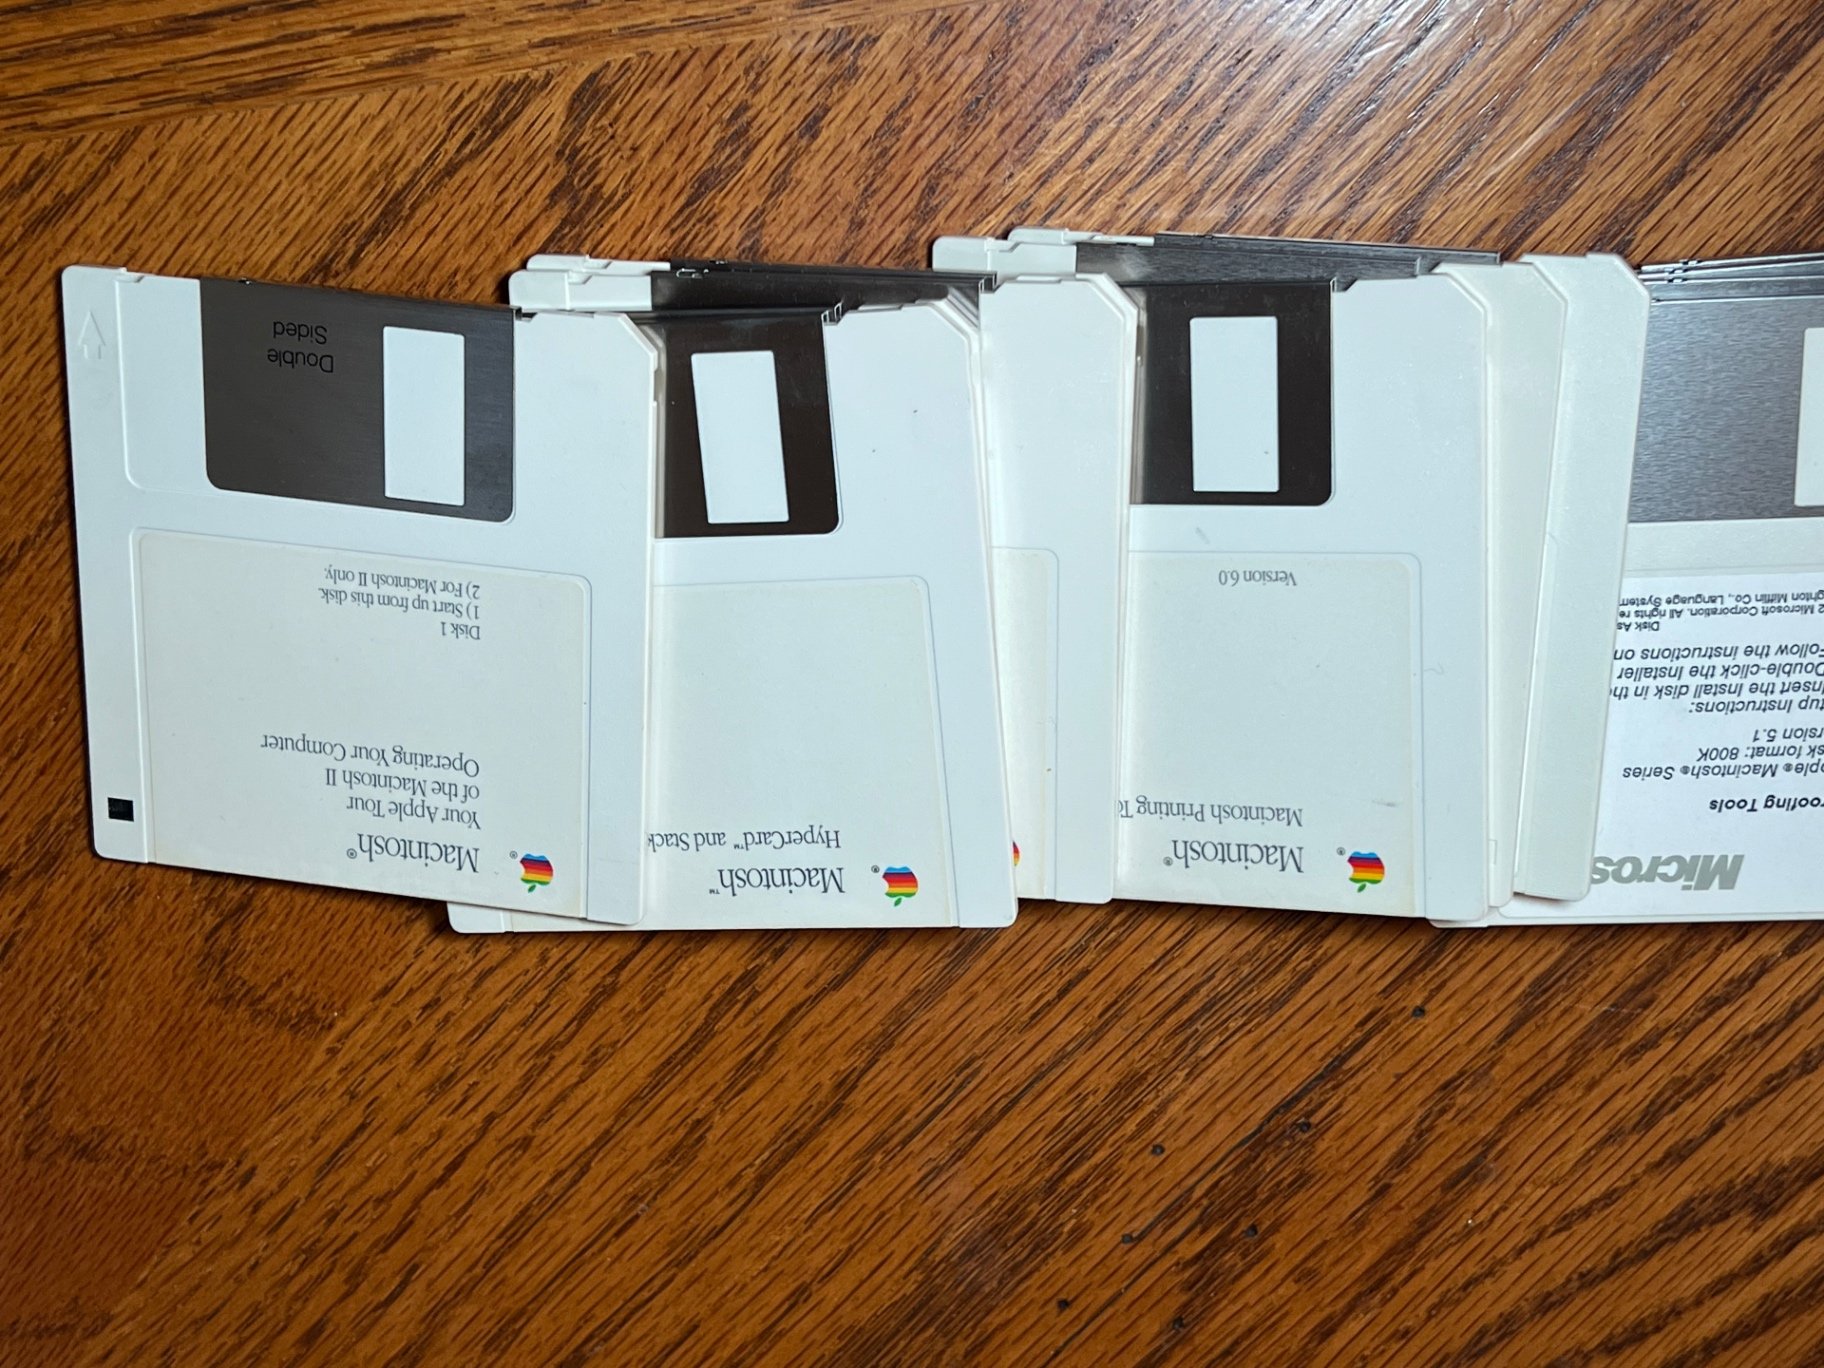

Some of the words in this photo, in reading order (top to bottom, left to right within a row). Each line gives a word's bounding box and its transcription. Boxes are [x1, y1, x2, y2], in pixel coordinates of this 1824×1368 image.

[273, 321, 327, 344] Sided
[267, 348, 333, 373] Double
[324, 565, 355, 584] only.
[359, 572, 367, 586] II
[1219, 570, 1239, 587] 6.0
[1243, 571, 1297, 586] Version
[370, 574, 436, 595] Macintosh
[440, 581, 462, 597] For
[466, 582, 480, 599] 2)
[318, 588, 347, 605] disk.
[351, 592, 374, 608] this
[377, 595, 408, 613] from
[412, 594, 429, 610] up
[1666, 594, 1724, 605] Language
[433, 601, 462, 617] Start
[466, 602, 479, 619] 1)
[1634, 607, 1666, 619] rights
[1670, 609, 1683, 618] All
[1687, 605, 1758, 617] Corporation.
[1762, 605, 1814, 616] Microsoft
[441, 622, 446, 636] 1
[450, 623, 480, 640] Disk
[1635, 621, 1660, 631] Disk
[1613, 649, 1635, 660] on
[1641, 646, 1739, 662] instructions
[1744, 645, 1770, 659] the
[1617, 666, 1684, 682] Installer
[1689, 665, 1716, 679] the
[1609, 687, 1628, 700] th
[1634, 686, 1649, 700] in
[1654, 685, 1689, 699] disk
[1693, 683, 1743, 698] Install
[1749, 682, 1775, 696] the
[1689, 700, 1793, 715] Instructions:
[1753, 729, 1777, 742] 5.1
[261, 734, 346, 761] Computer
[1696, 747, 1739, 761] 800K
[1745, 745, 1802, 759] format:
[351, 746, 389, 767] Your
[392, 745, 479, 777] Operating
[326, 768, 336, 786] II
[1623, 767, 1675, 780] Series
[343, 770, 427, 796] Macintosh
[432, 781, 457, 802] the
[461, 785, 479, 803] of
[347, 797, 385, 818] Tour
[388, 798, 438, 823] Apple
[1136, 795, 1205, 822] Printing
[1710, 799, 1757, 813] Tools
[442, 808, 480, 830] Your
[1210, 804, 1302, 827] Macintosh
[694, 832, 726, 852] and
[1591, 854, 1744, 890] Micros
